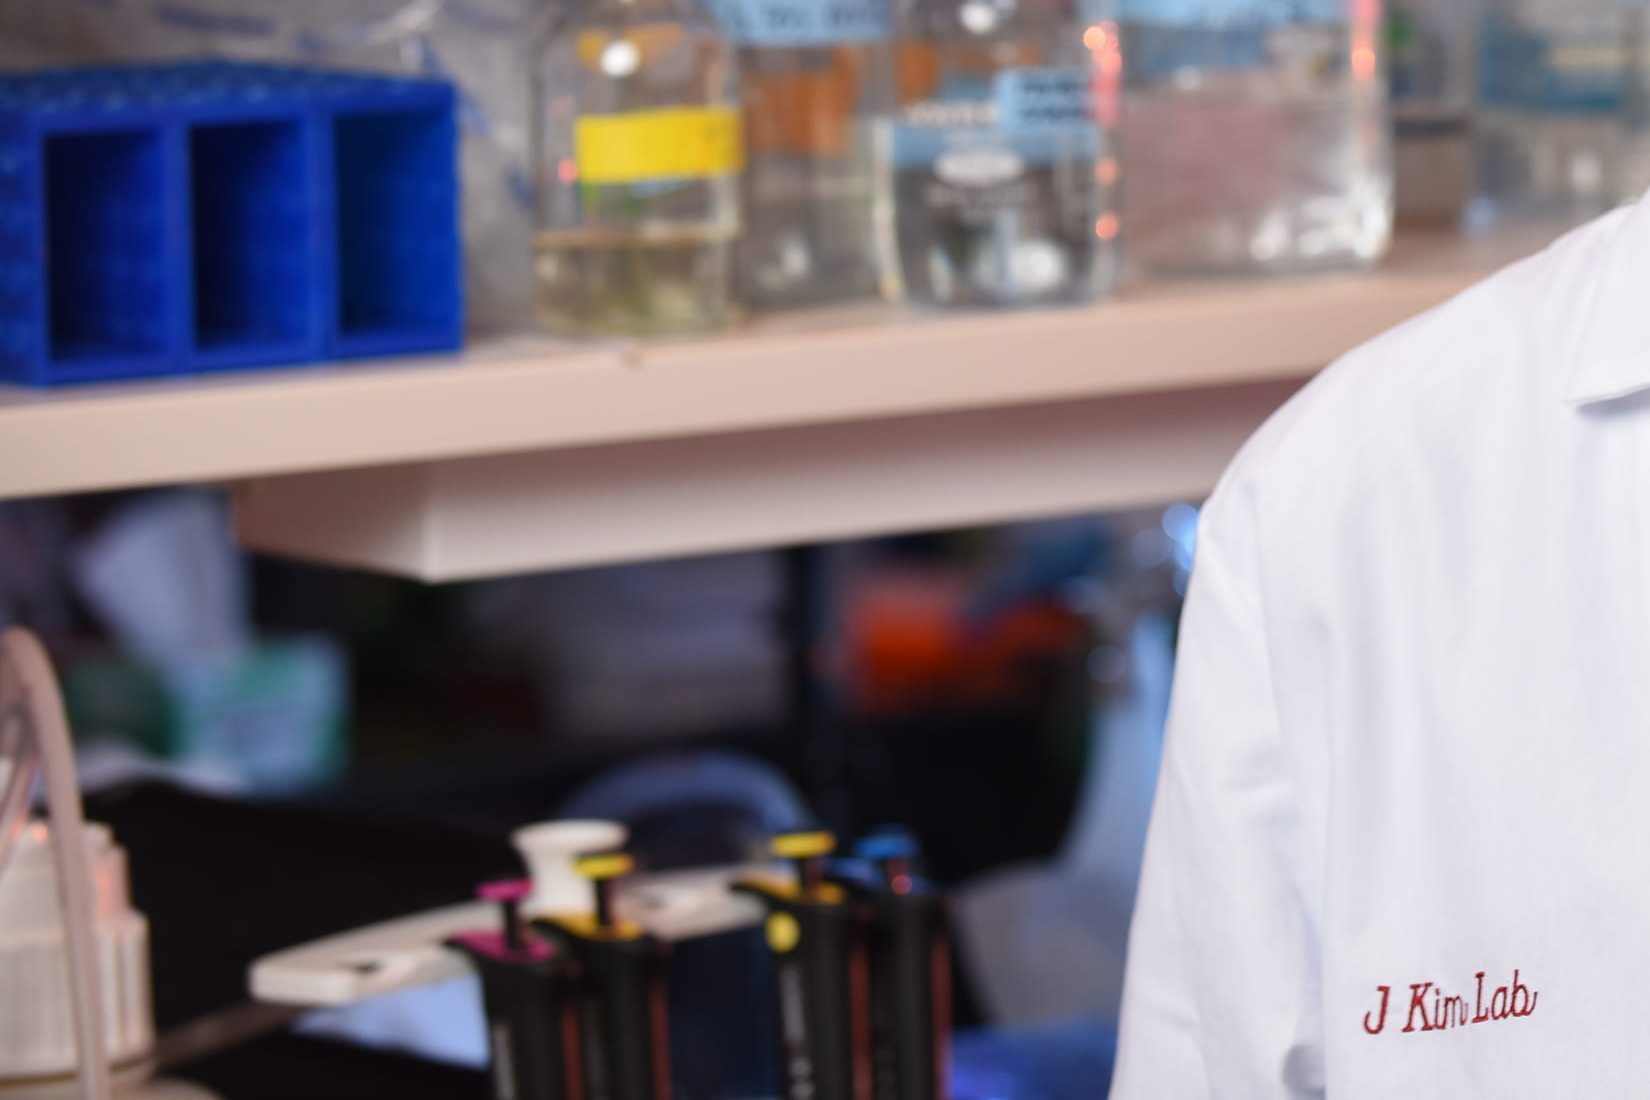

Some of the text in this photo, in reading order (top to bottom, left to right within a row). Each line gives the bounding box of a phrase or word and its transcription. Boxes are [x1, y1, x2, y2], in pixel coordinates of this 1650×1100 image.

[1363, 968, 1538, 1034] J Kim Lab
